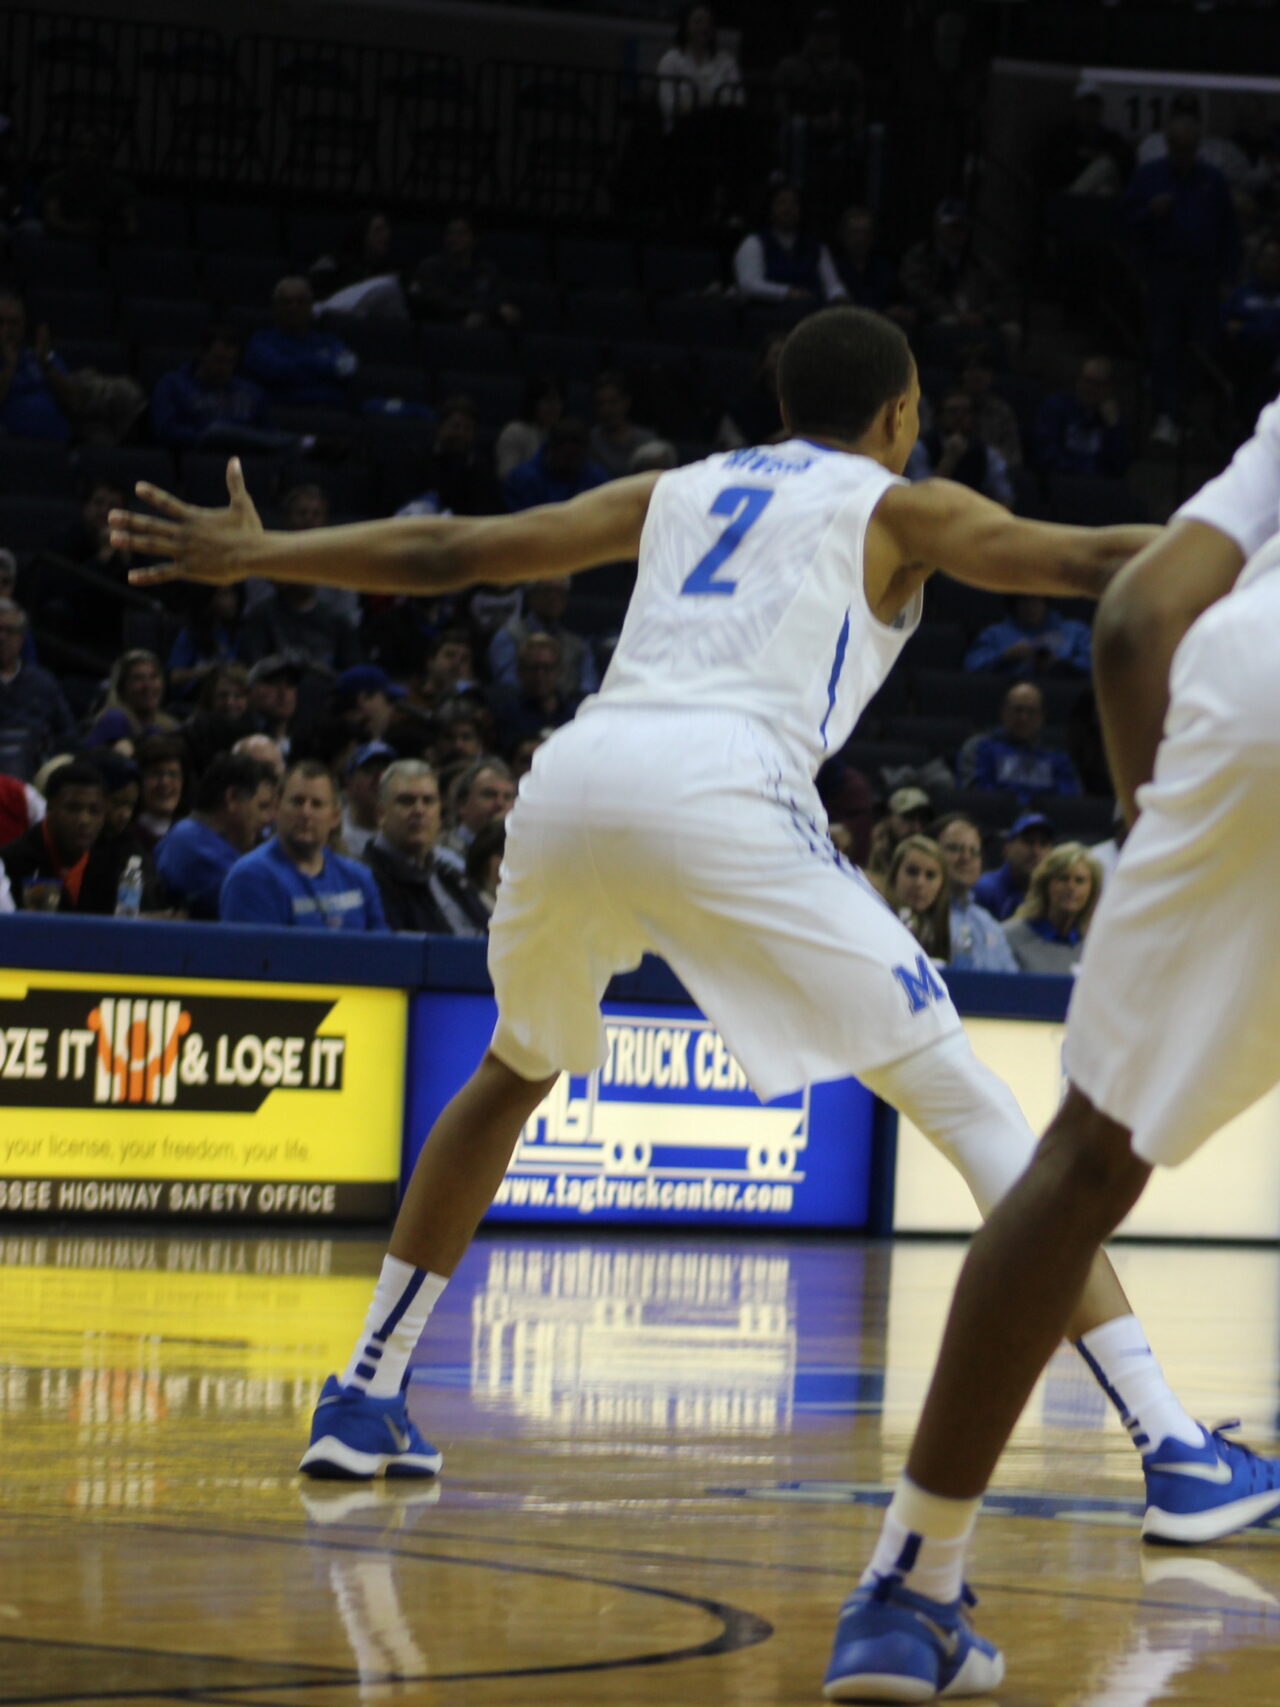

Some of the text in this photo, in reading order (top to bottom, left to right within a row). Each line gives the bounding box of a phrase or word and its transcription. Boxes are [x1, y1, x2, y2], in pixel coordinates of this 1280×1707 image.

[680, 485, 775, 594] 2
[891, 953, 944, 1014] M
[0, 1027, 346, 1088] ZE IT & LOSE IT
[602, 1025, 691, 1088] TRUCK
[5, 1138, 44, 1164] your
[119, 1138, 158, 1166] your
[242, 1139, 279, 1167] your
[59, 1181, 162, 1212] HIGHWAY
[169, 1182, 252, 1213] SAFETY
[258, 1183, 336, 1214] OFFICE
